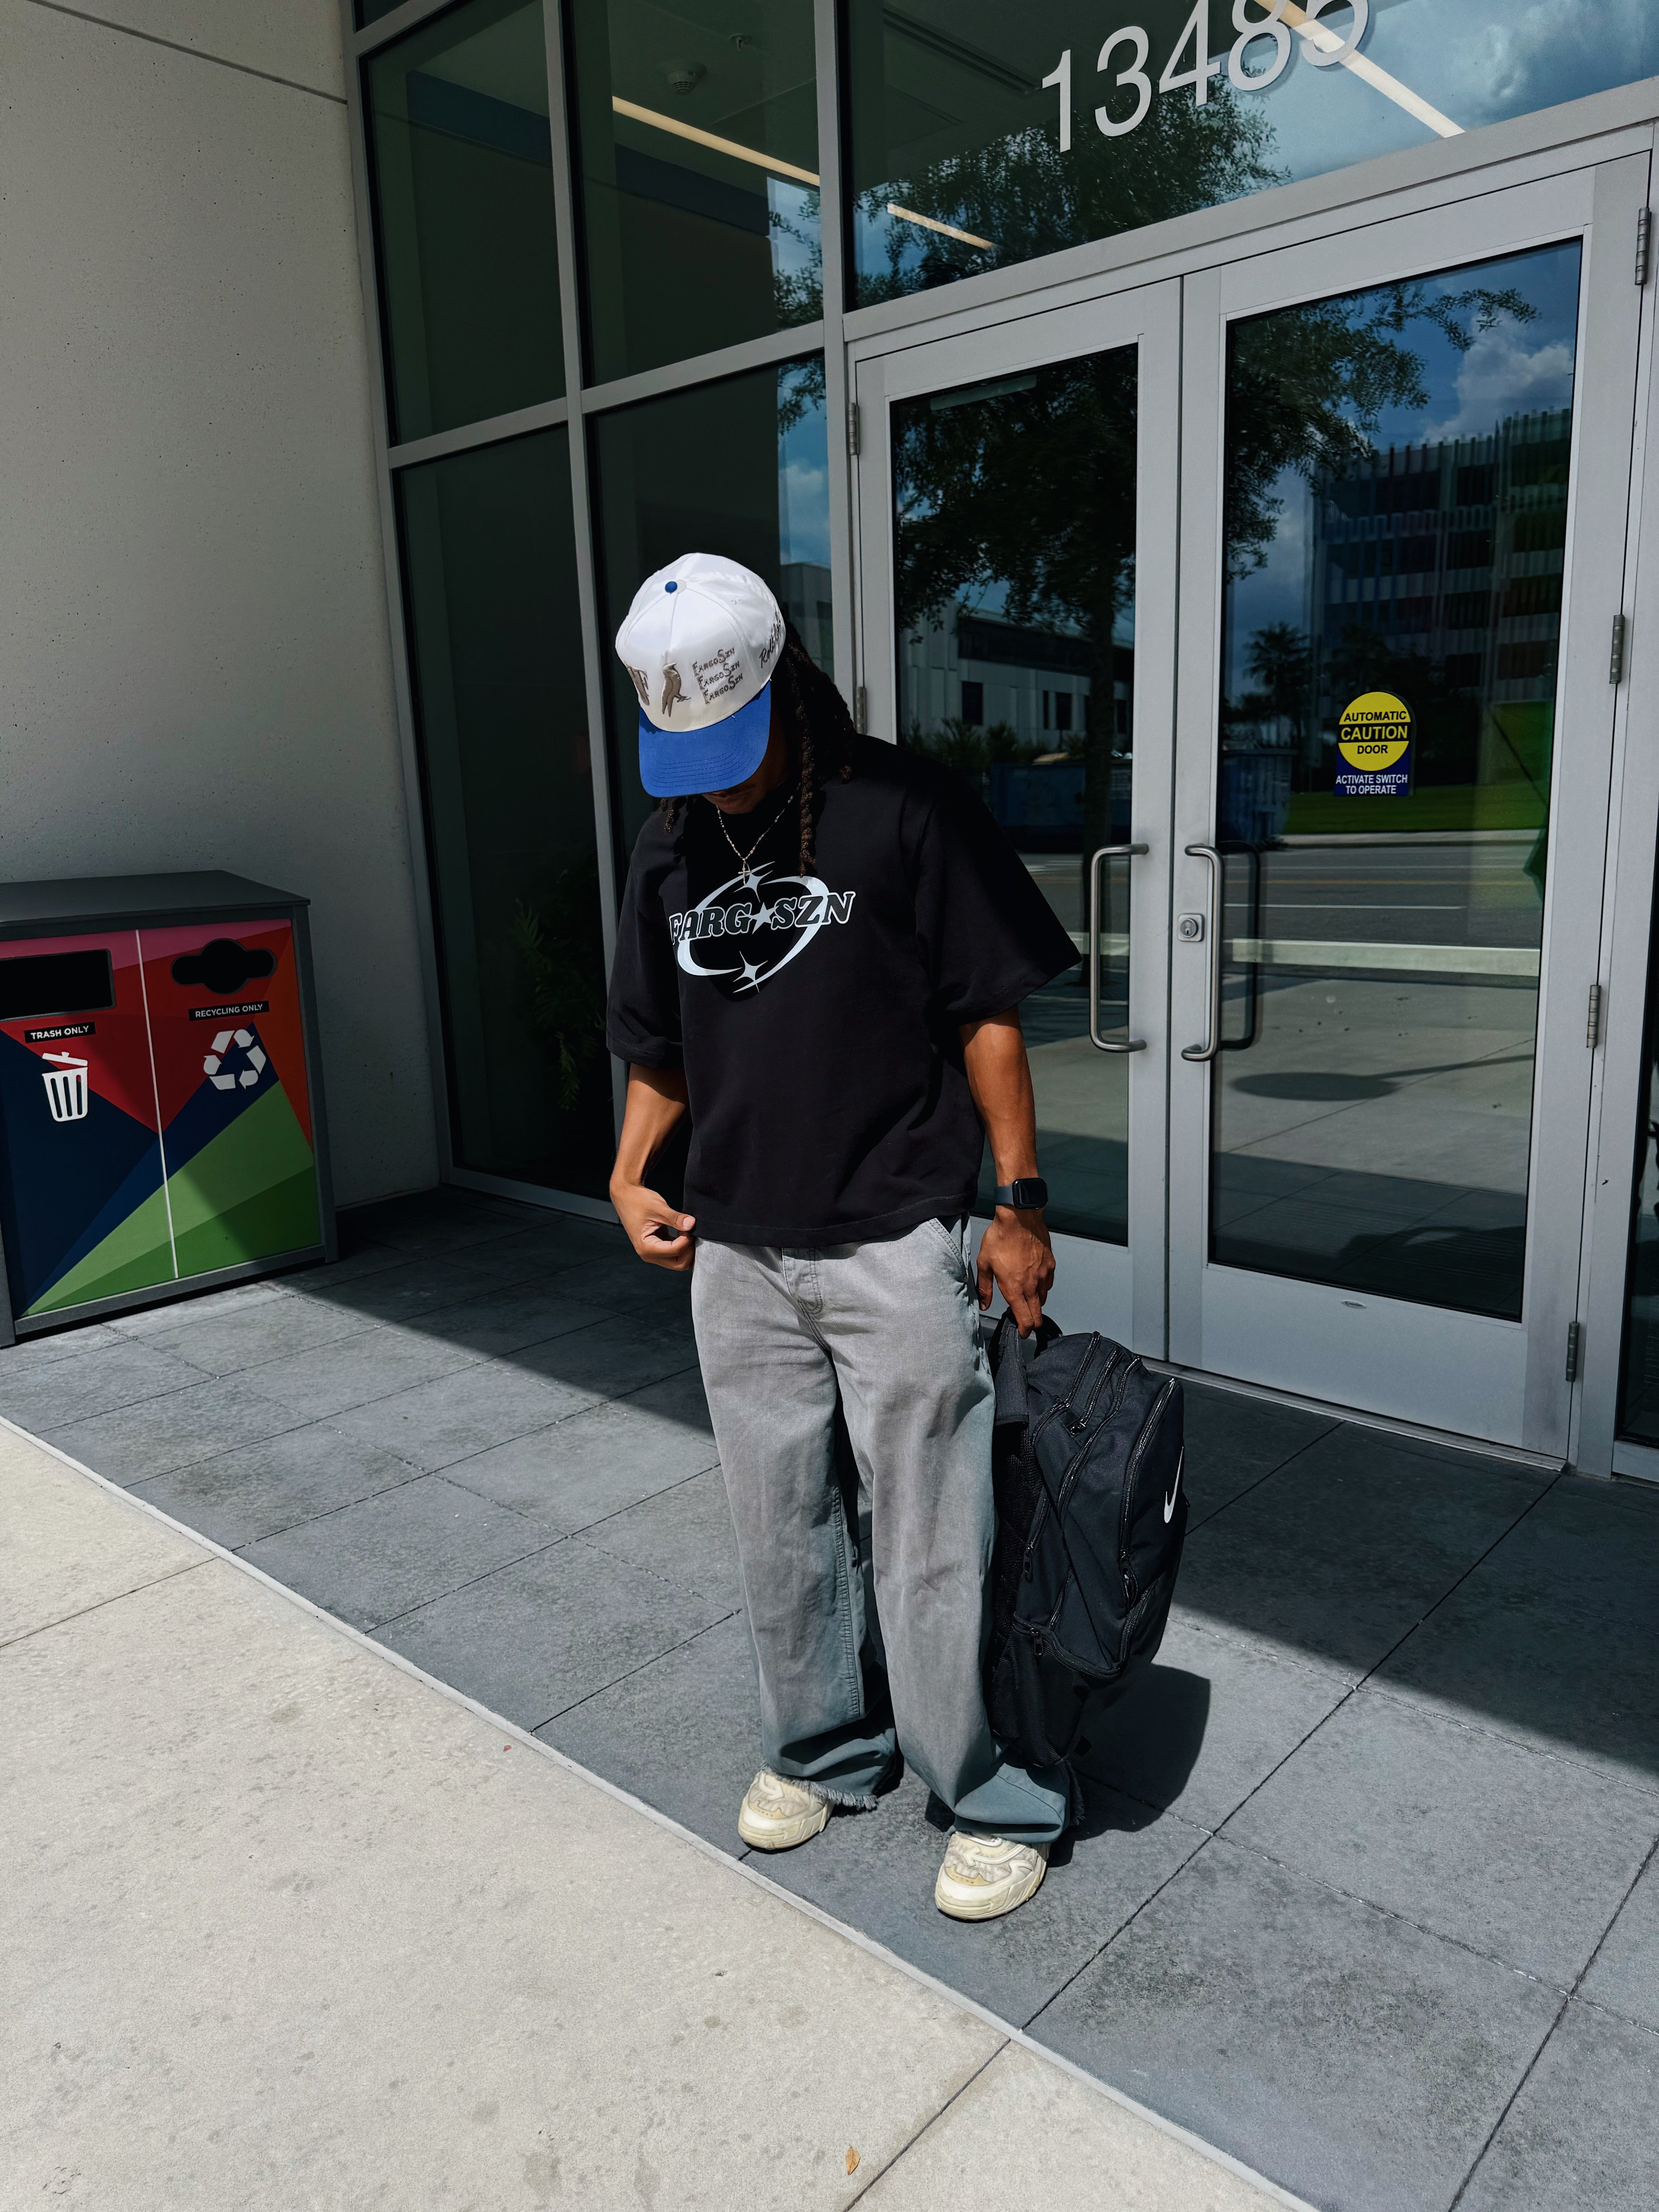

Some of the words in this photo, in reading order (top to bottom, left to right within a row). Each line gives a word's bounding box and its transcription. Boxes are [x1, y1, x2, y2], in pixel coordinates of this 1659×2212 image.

[1042, 0, 1369, 153] 13485
[1344, 711, 1407, 722] AUTOMATIC
[1341, 725, 1408, 740] CAUTION
[1357, 745, 1388, 754] DOOR
[1336, 775, 1374, 784] ACTIVATE
[1376, 775, 1408, 783] SWITCH
[1346, 785, 1356, 794] TO
[1358, 785, 1396, 794] OPERATE
[195, 1006, 240, 1018] RECYCLING
[242, 1003, 263, 1012] ONLY
[31, 1029, 62, 1040] TRASH
[64, 1025, 89, 1035] ONLY
